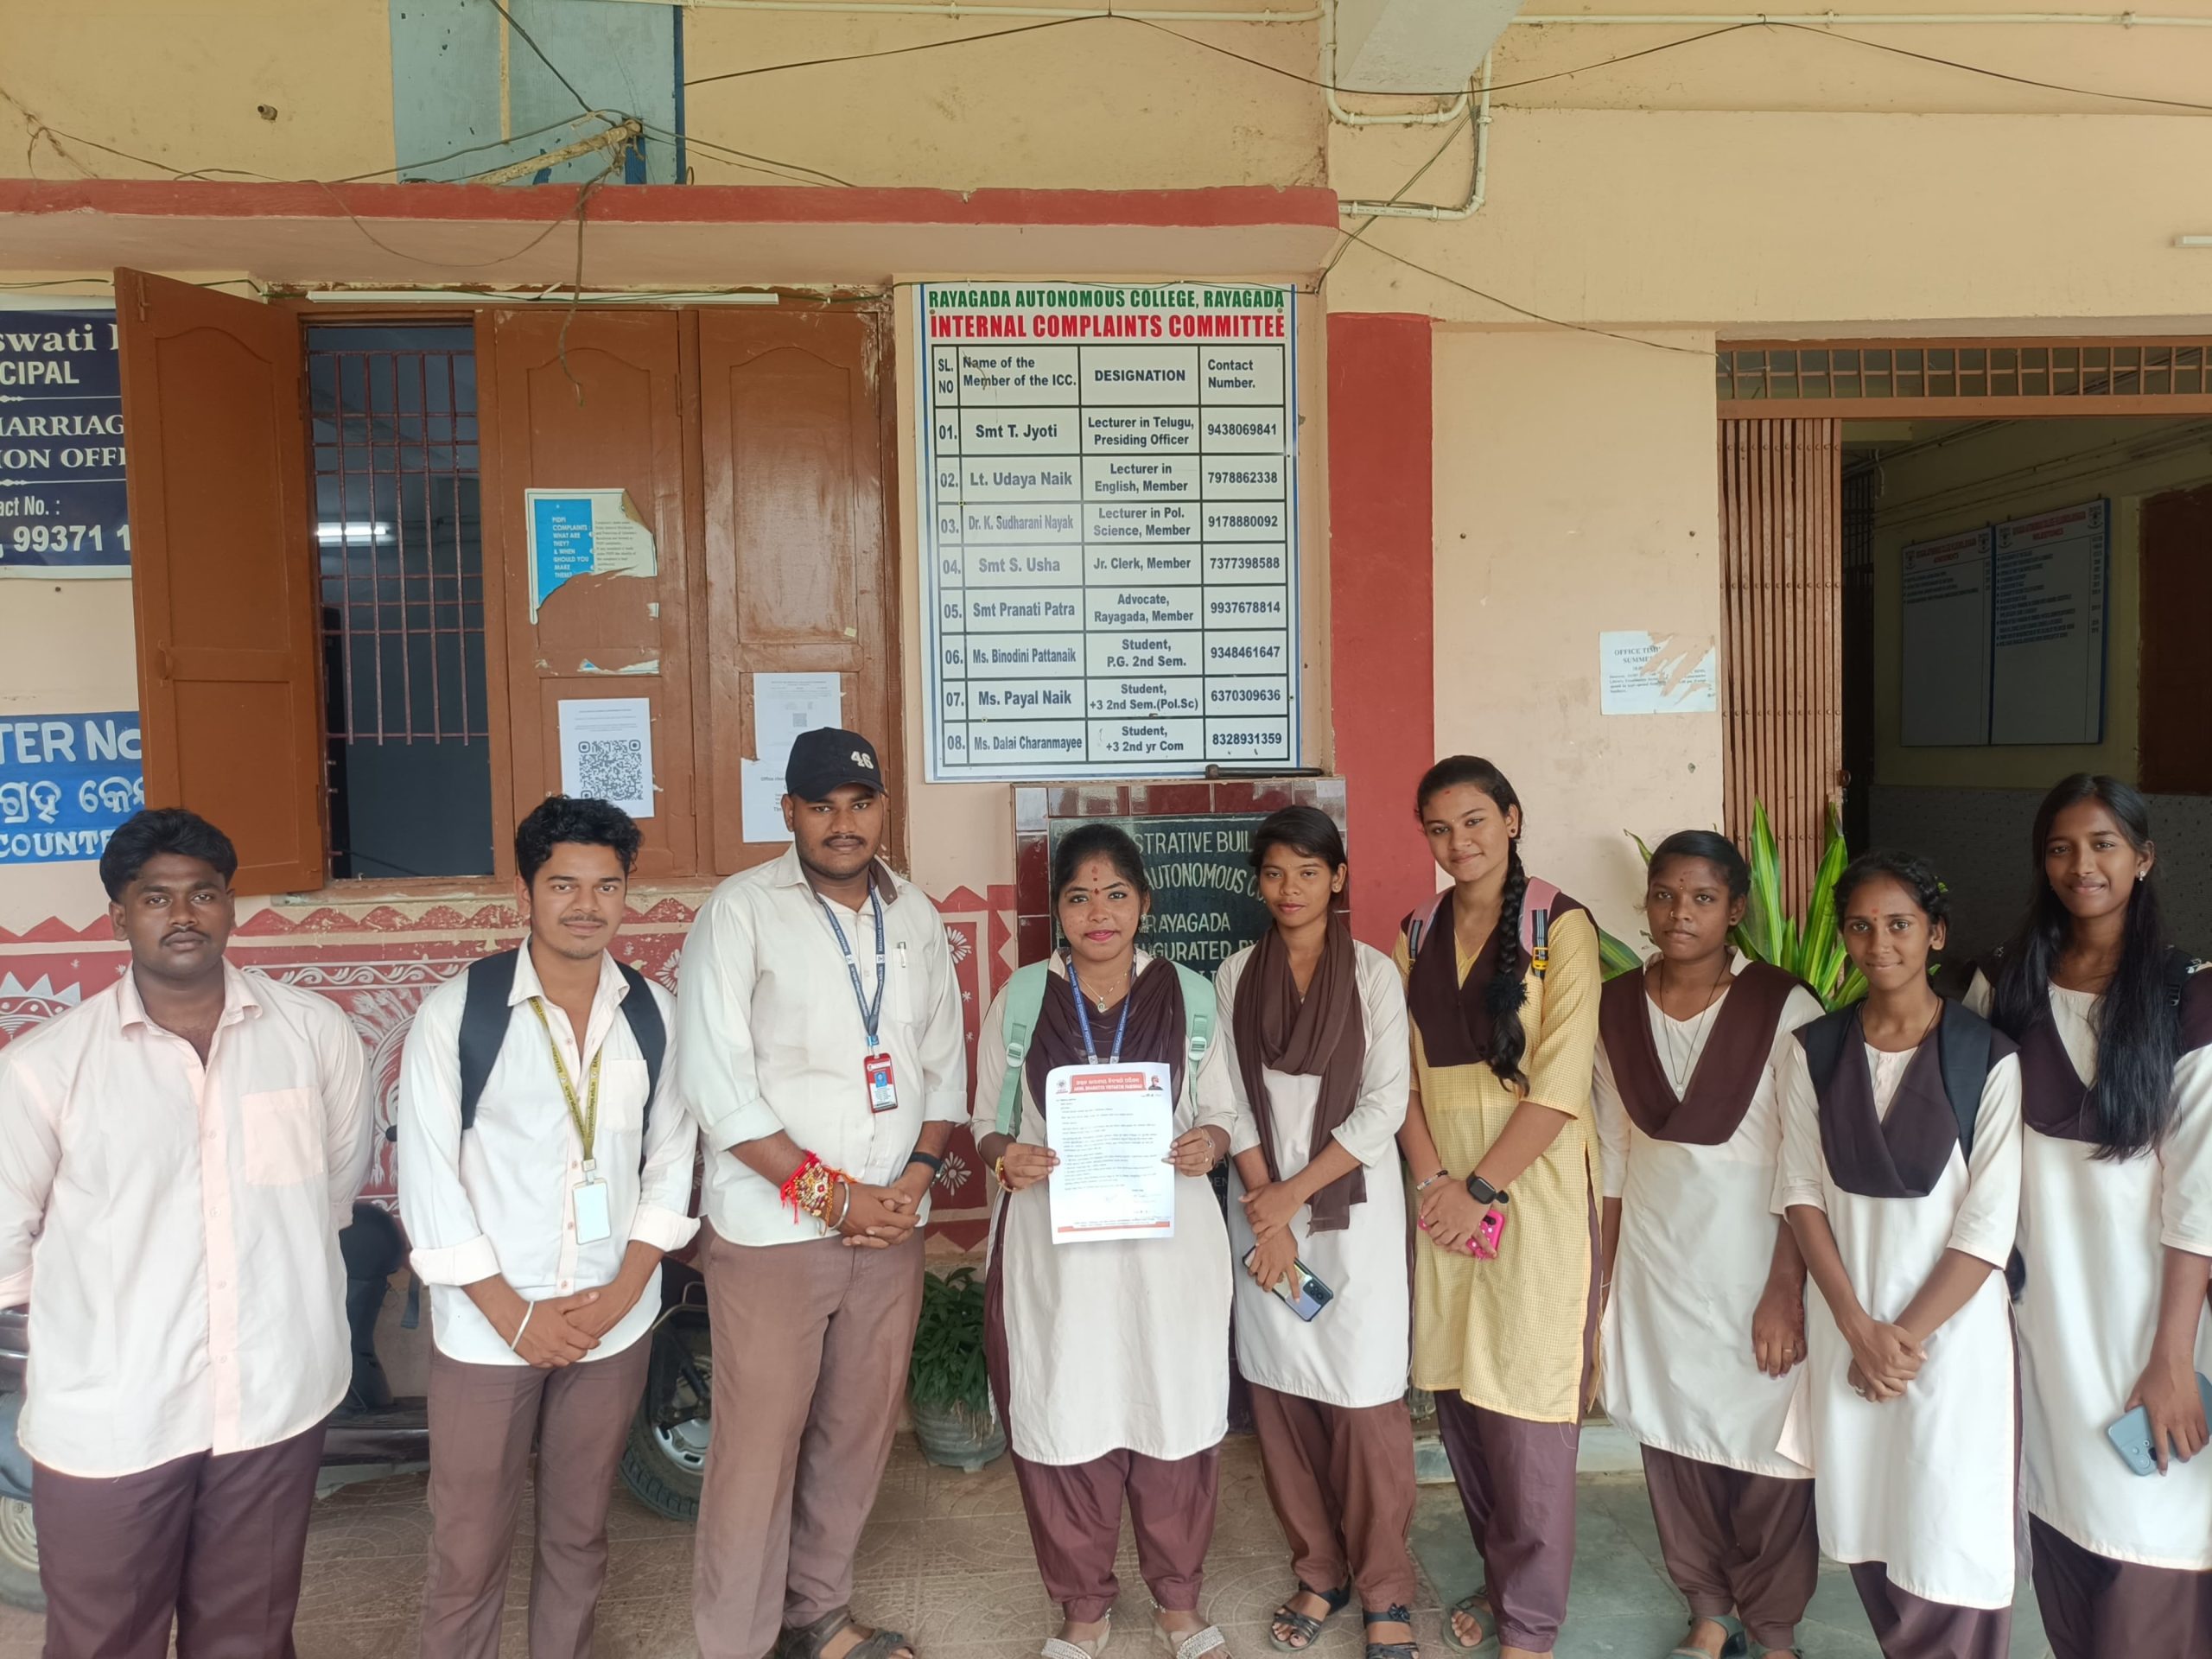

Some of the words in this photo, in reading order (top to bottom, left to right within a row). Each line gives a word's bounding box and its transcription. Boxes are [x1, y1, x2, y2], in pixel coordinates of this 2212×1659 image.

[930, 291, 1010, 308] RAYAGADA
[1015, 290, 1124, 308] AUTONOMOUS
[1130, 290, 1199, 308] COLLEGE,
[1205, 290, 1284, 308] RAYAGADA
[931, 315, 1027, 338] INTERNAL
[1033, 315, 1162, 337] COMPLAINTS
[1168, 315, 1284, 337] COMMITTEE
[938, 359, 953, 372] SL.
[963, 358, 997, 368] Name
[1001, 357, 1012, 368] of
[1015, 357, 1034, 368] the
[1208, 359, 1253, 372] Contact
[963, 375, 1010, 387] Member
[1014, 375, 1026, 386] of
[1029, 375, 1048, 386] the
[1052, 374, 1076, 385] ICC.
[1095, 370, 1185, 382] DESIGNATION
[938, 380, 953, 394] NO
[1208, 378, 1255, 389] Number.
[1088, 417, 1136, 429] Lecturer
[1140, 417, 1150, 429] in
[1154, 416, 1194, 431] Telugu,
[1208, 423, 1276, 435] 9438069841
[939, 426, 957, 441] 01.
[976, 425, 1005, 438] Smt
[1008, 425, 1019, 437] T.
[1023, 424, 1057, 441] Jyoti
[1095, 435, 1147, 447] Presiding
[1151, 434, 1189, 445] Officer
[1110, 464, 1158, 474] Lecturer
[1161, 463, 1172, 474] in
[940, 474, 959, 488] 02.
[969, 474, 988, 486] Lt.
[993, 473, 1036, 489] Udaya
[1040, 472, 1072, 485] Naik
[1208, 473, 1277, 484] 7978862338
[1095, 480, 1139, 494] English,
[1142, 480, 1187, 492] Member
[25, 496, 49, 516] No.
[1099, 508, 1147, 519] Lecturer
[1151, 507, 1160, 518] in
[1164, 507, 1184, 518] Pol.
[941, 519, 959, 534] 03.
[969, 517, 981, 530] Dr.
[983, 516, 994, 529] K.
[995, 515, 1042, 530] Sudharani
[1044, 514, 1073, 531] Nayak
[1208, 516, 1278, 527] 9178880092
[1094, 525, 1142, 538] Science,
[1146, 524, 1191, 536] Member
[14, 525, 103, 552] 99371
[944, 560, 961, 575] 04.
[979, 559, 1006, 573] Smt
[1009, 559, 1022, 572] S.
[1027, 557, 1060, 572] Usha
[1094, 558, 1107, 569] Jr.
[1111, 557, 1143, 571] Clerk,
[1147, 557, 1191, 569] Member
[1210, 557, 1280, 569] 7377398588
[1118, 594, 1170, 607] Advocate,
[1211, 602, 1280, 613] 9937678814
[944, 604, 962, 619] 05.
[973, 604, 996, 617] Smt
[1000, 602, 1040, 616] Pranati
[1044, 603, 1075, 616] Patra
[1095, 611, 1148, 625] Rayagada,
[1152, 610, 1193, 621] Member
[1122, 639, 1172, 652] Student,
[1211, 646, 1280, 658] 9348461647
[945, 650, 963, 664] 06.
[973, 650, 988, 664] Ms.
[991, 649, 1029, 664] Binodini
[1033, 648, 1076, 663] Pattanaik
[1107, 657, 1128, 668] P.G.
[1133, 656, 1154, 667] 2nd
[1157, 656, 1186, 667] Sem.
[1121, 683, 1167, 696] Student,
[1211, 690, 1281, 702] 6370309636
[946, 692, 964, 707] 07.
[979, 692, 1000, 706] Ms.
[1004, 691, 1039, 708] Payal
[1042, 691, 1071, 704] Naik
[1090, 700, 1103, 710] +3
[1106, 699, 1127, 710] 2nd
[1130, 698, 1198, 711] Sem.(Pol.Sc)
[1122, 725, 1167, 738] Student,
[948, 735, 965, 750] 08.
[975, 736, 989, 751] Ms.
[994, 736, 1017, 750] Dalai
[1019, 735, 1082, 752] Charanmayee
[1106, 741, 1120, 752] +3
[1123, 741, 1142, 752] 2nd
[1146, 742, 1157, 754] yr
[1160, 740, 1184, 751] Com
[1212, 734, 1281, 746] 8328931359
